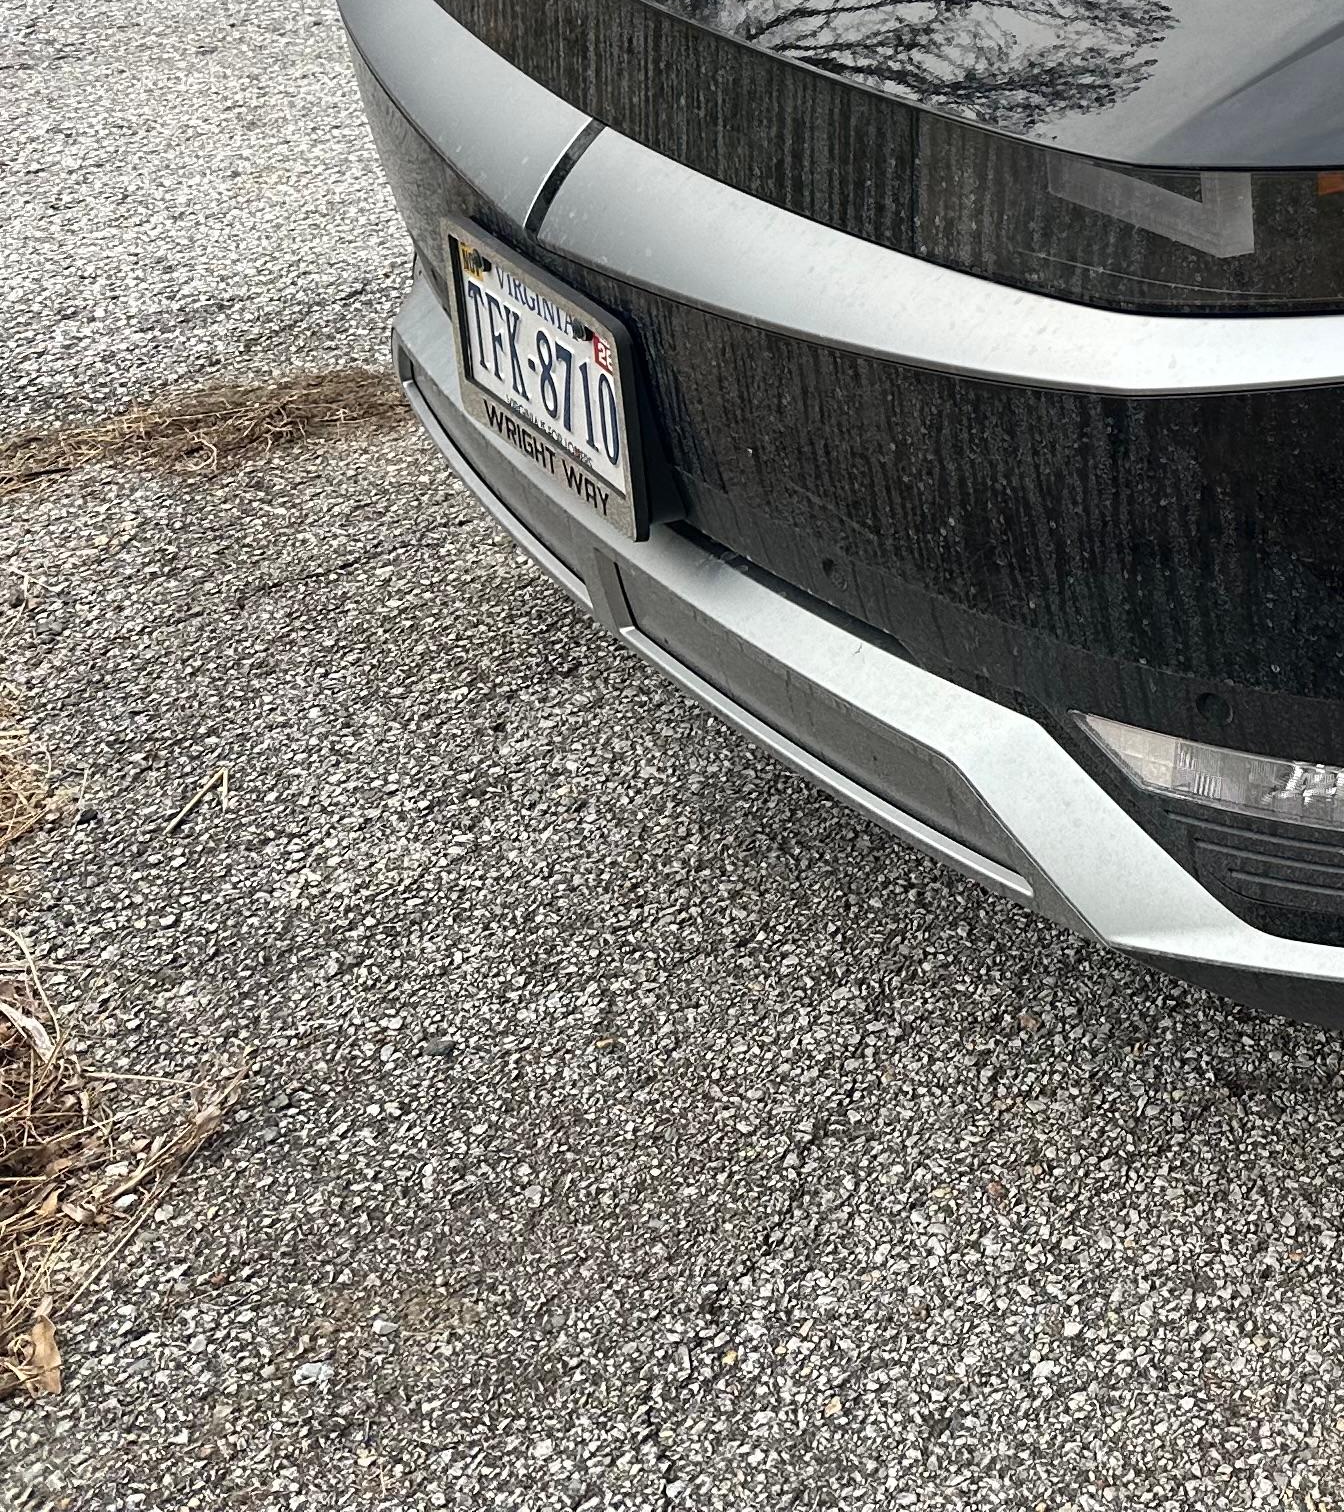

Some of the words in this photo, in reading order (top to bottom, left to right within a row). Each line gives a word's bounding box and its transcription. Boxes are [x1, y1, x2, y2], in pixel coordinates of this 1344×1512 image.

[494, 266, 575, 335] VIRGINIA
[467, 280, 619, 466] TFK-8710
[483, 398, 556, 474] WRIGHT
[561, 459, 610, 516] WAY
